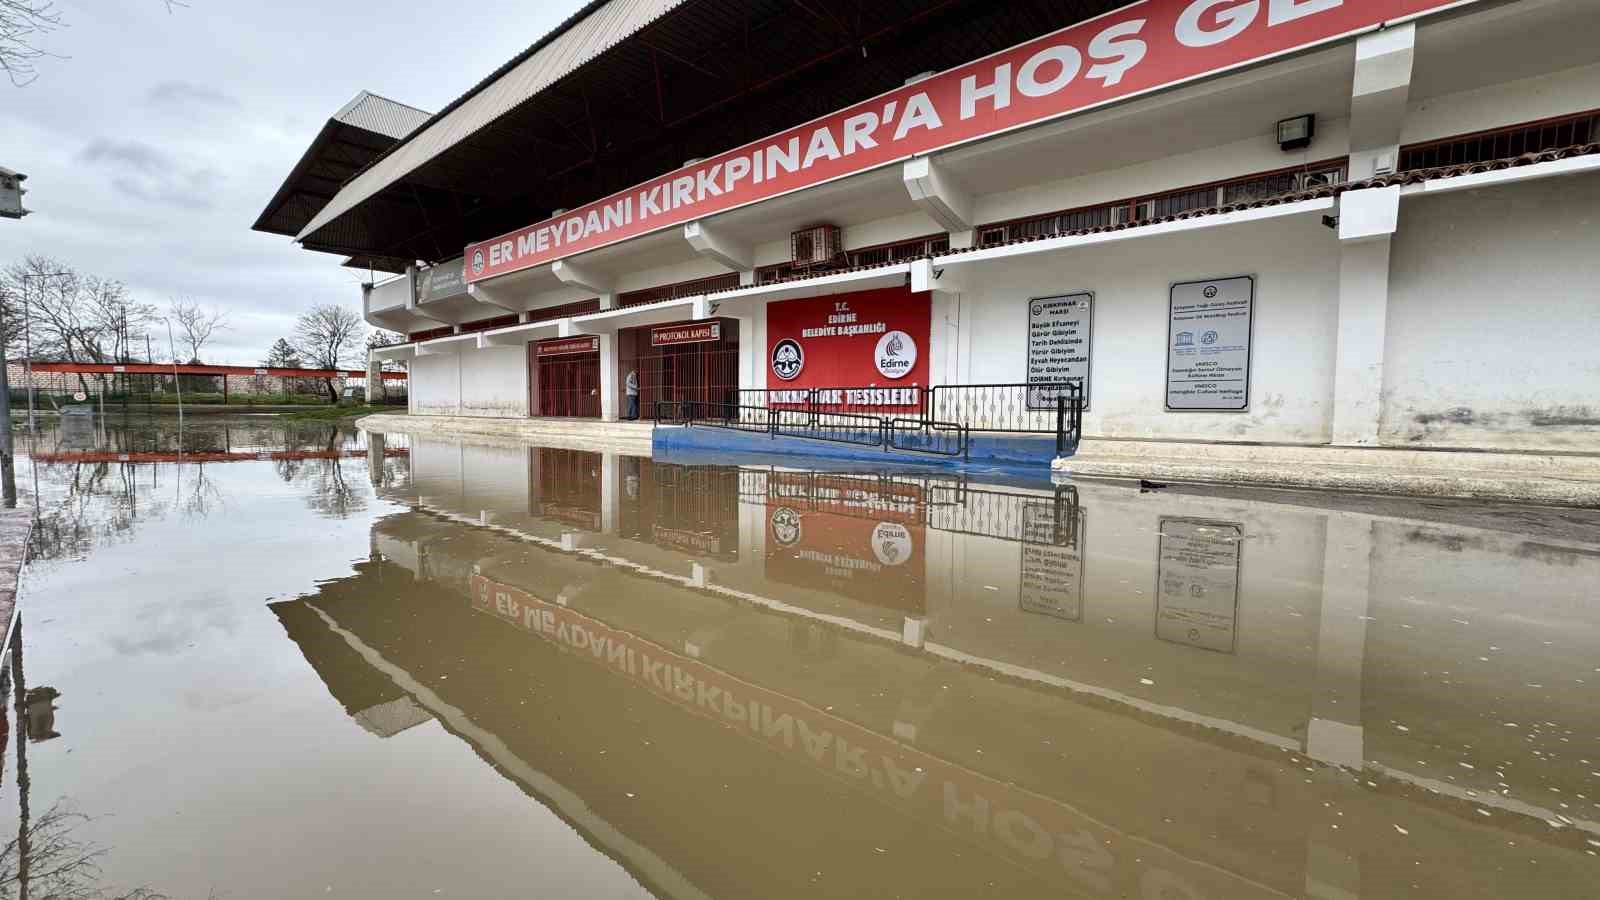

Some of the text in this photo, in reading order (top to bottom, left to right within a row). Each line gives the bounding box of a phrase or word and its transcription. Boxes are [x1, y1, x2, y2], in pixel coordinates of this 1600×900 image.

[489, 241, 513, 266] ER
[517, 197, 632, 258] MEYDANI
[639, 92, 943, 220] KIRKPINAR'A
[960, 19, 1148, 120] HOŞ
[835, 302, 849, 311] T.C.
[828, 313, 857, 324] EDİRNE
[659, 330, 690, 341] PROTOKOL
[802, 323, 886, 338] BELEDİYE BAŞKANLIĞI
[880, 358, 909, 369] Edirne
